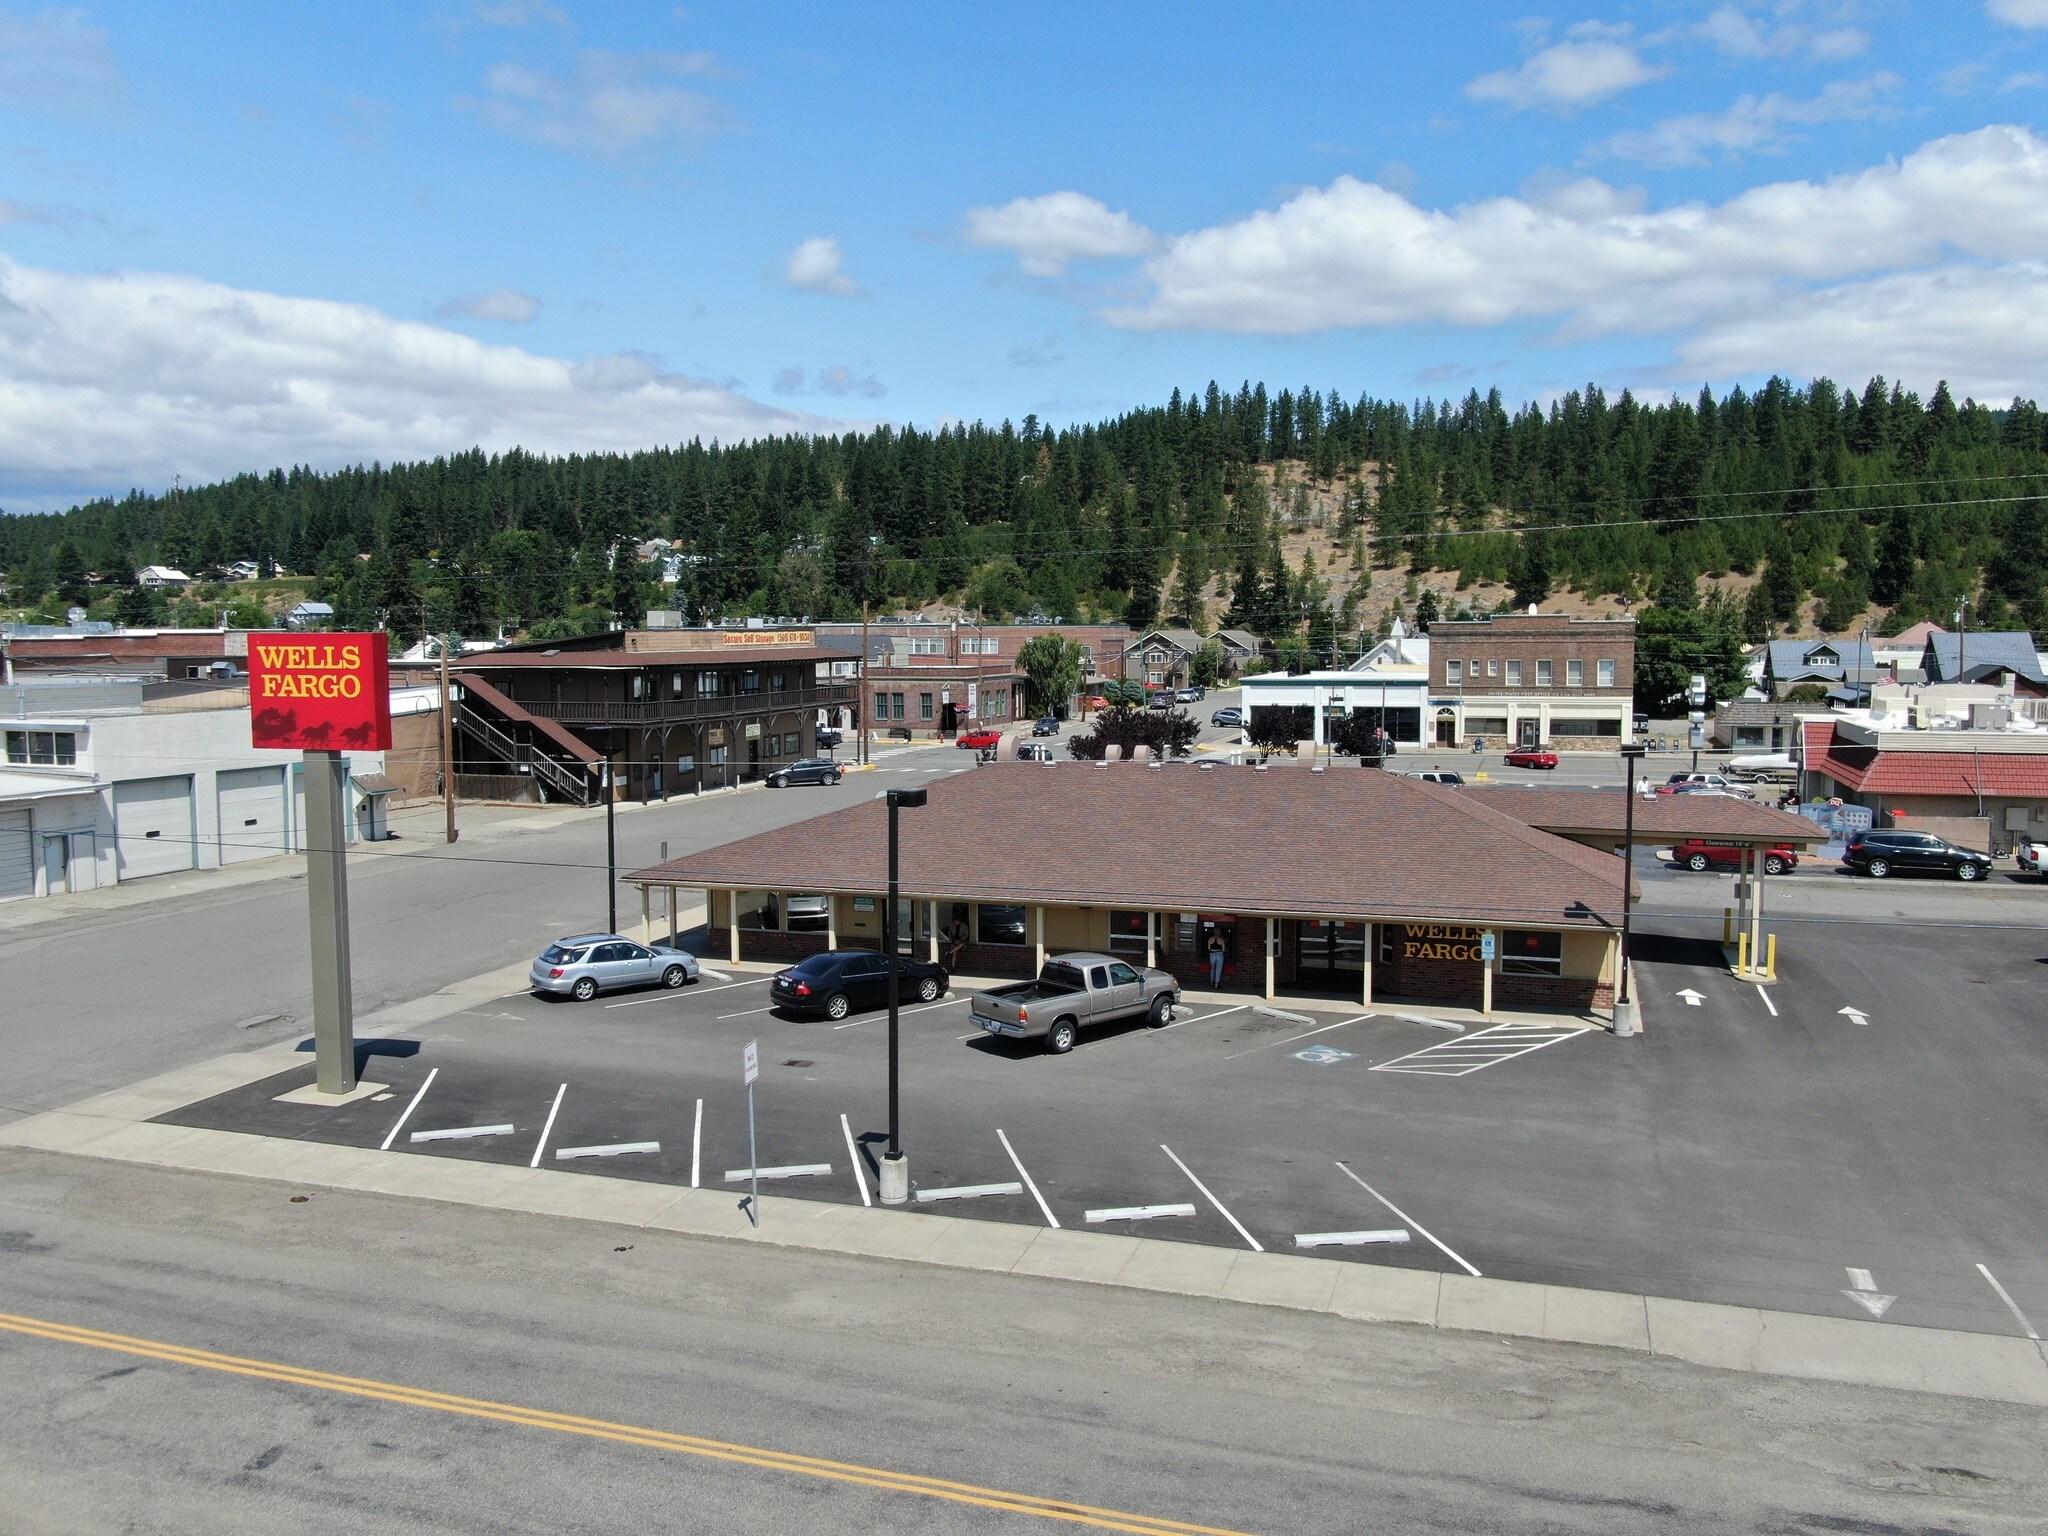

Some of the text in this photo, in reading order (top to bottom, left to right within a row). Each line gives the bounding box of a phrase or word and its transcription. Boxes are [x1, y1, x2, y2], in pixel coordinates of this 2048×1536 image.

[724, 634, 742, 643] Secure
[756, 634, 775, 644] Storage
[256, 645, 361, 670] WELLS
[261, 674, 361, 698] FARGO
[1405, 923, 1485, 940] WELLS
